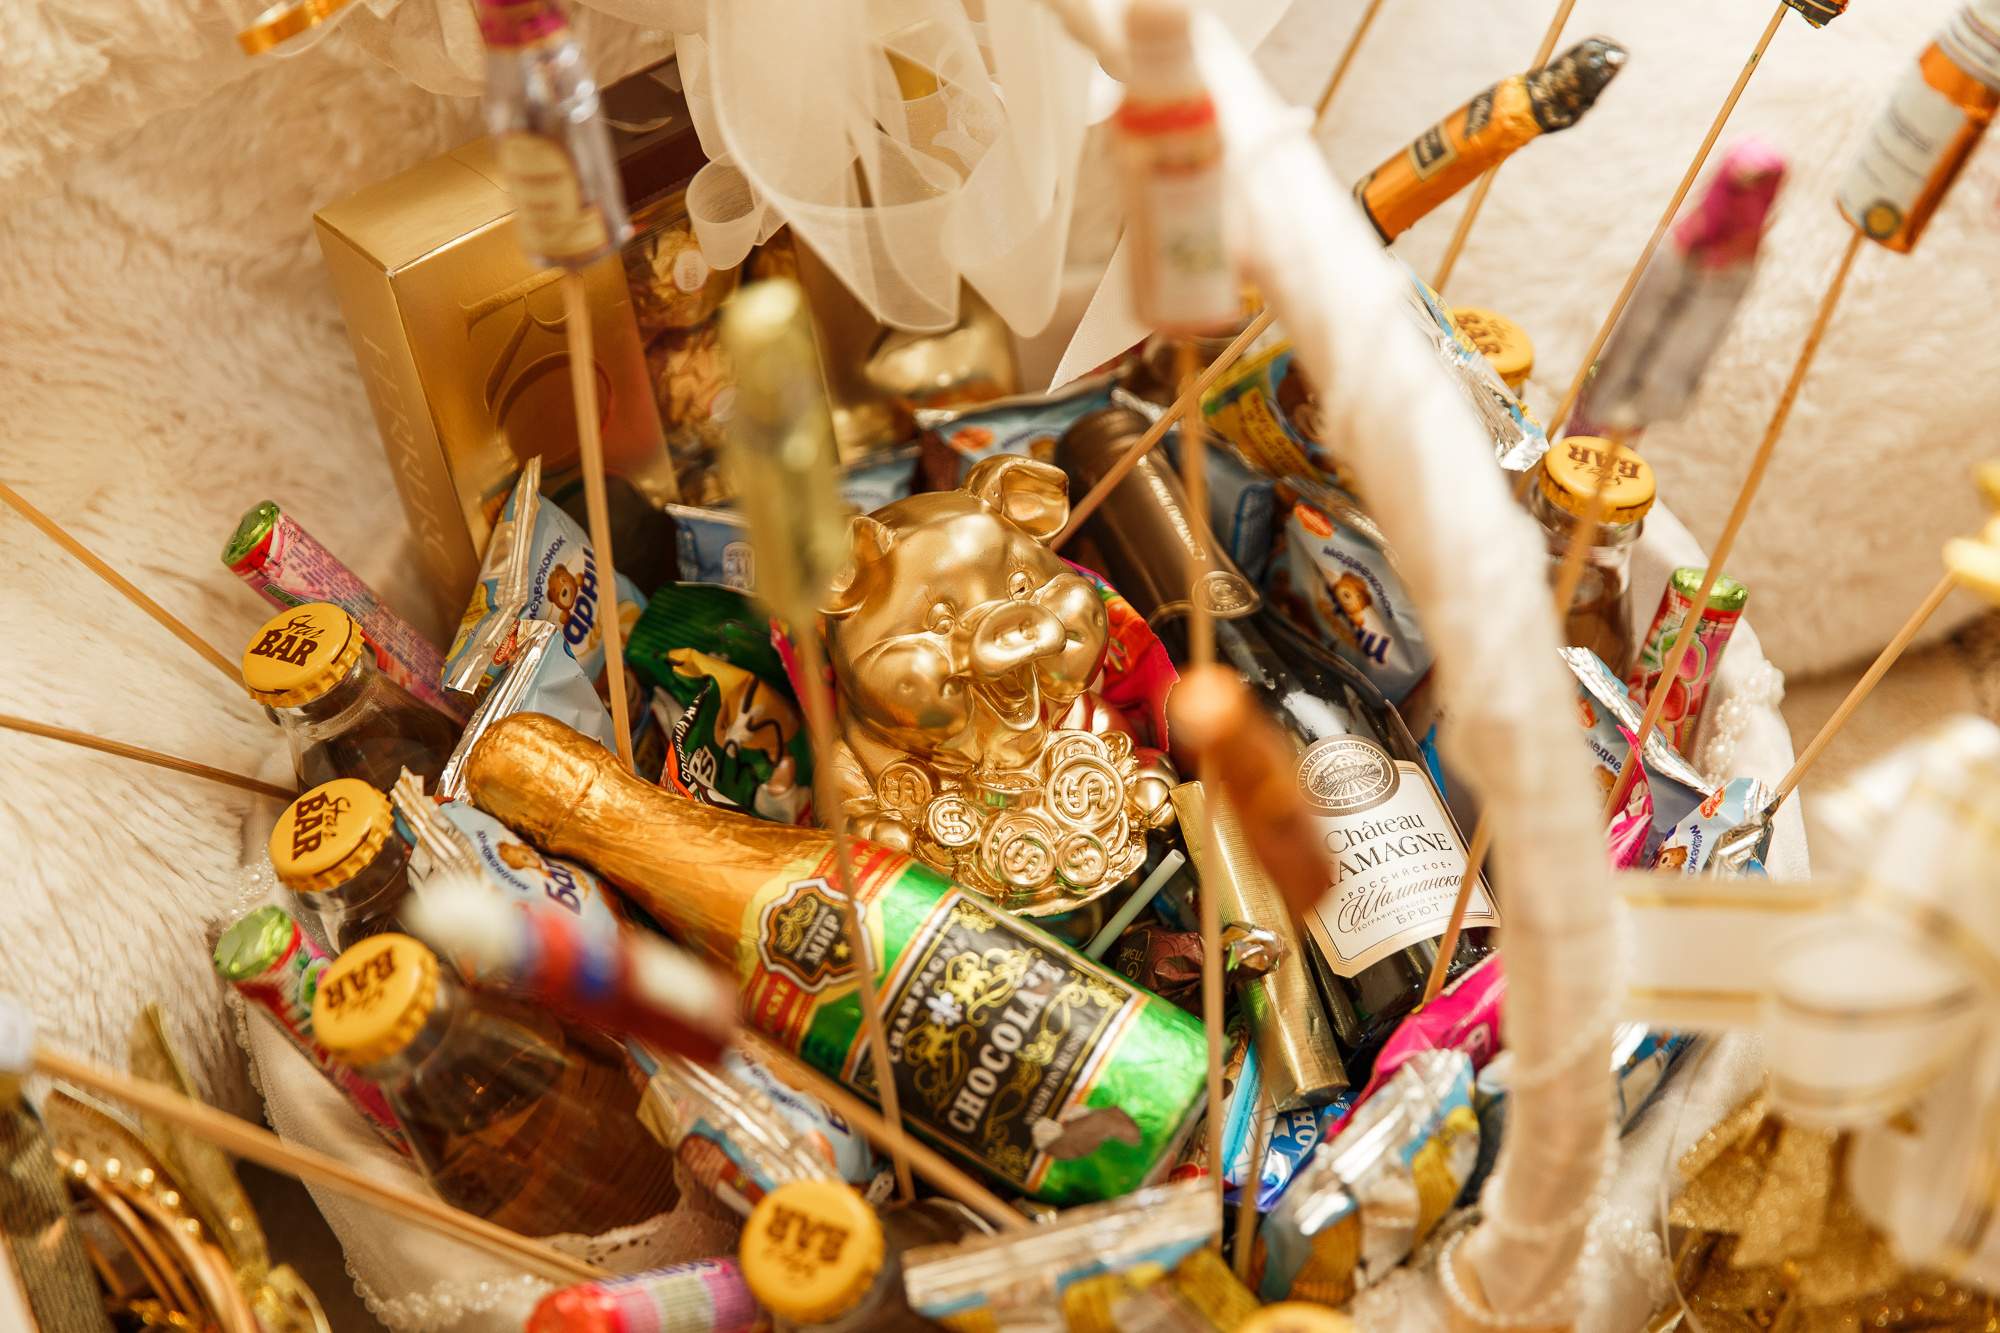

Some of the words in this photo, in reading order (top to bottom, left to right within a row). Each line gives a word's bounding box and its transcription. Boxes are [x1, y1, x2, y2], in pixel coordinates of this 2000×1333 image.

[563, 547, 599, 645] арн
[277, 614, 325, 640] Star
[250, 628, 318, 667] BAR
[1335, 743, 1385, 765] TAMAGNE
[1584, 736, 1622, 774] медве
[1325, 782, 1386, 807] WINERY
[291, 790, 327, 862] BAR
[322, 796, 351, 841] Star
[1325, 814, 1426, 855] Château
[1327, 833, 1453, 890] AMAGNE
[1688, 823, 1703, 876] медвежо
[1348, 862, 1447, 898] РОССИЙСКОЕ
[1428, 891, 1461, 902] УКАЗАН
[1396, 902, 1440, 925] БРЮТ
[325, 946, 396, 1010] BAR
[947, 959, 1066, 1134] CHOCOLATE
